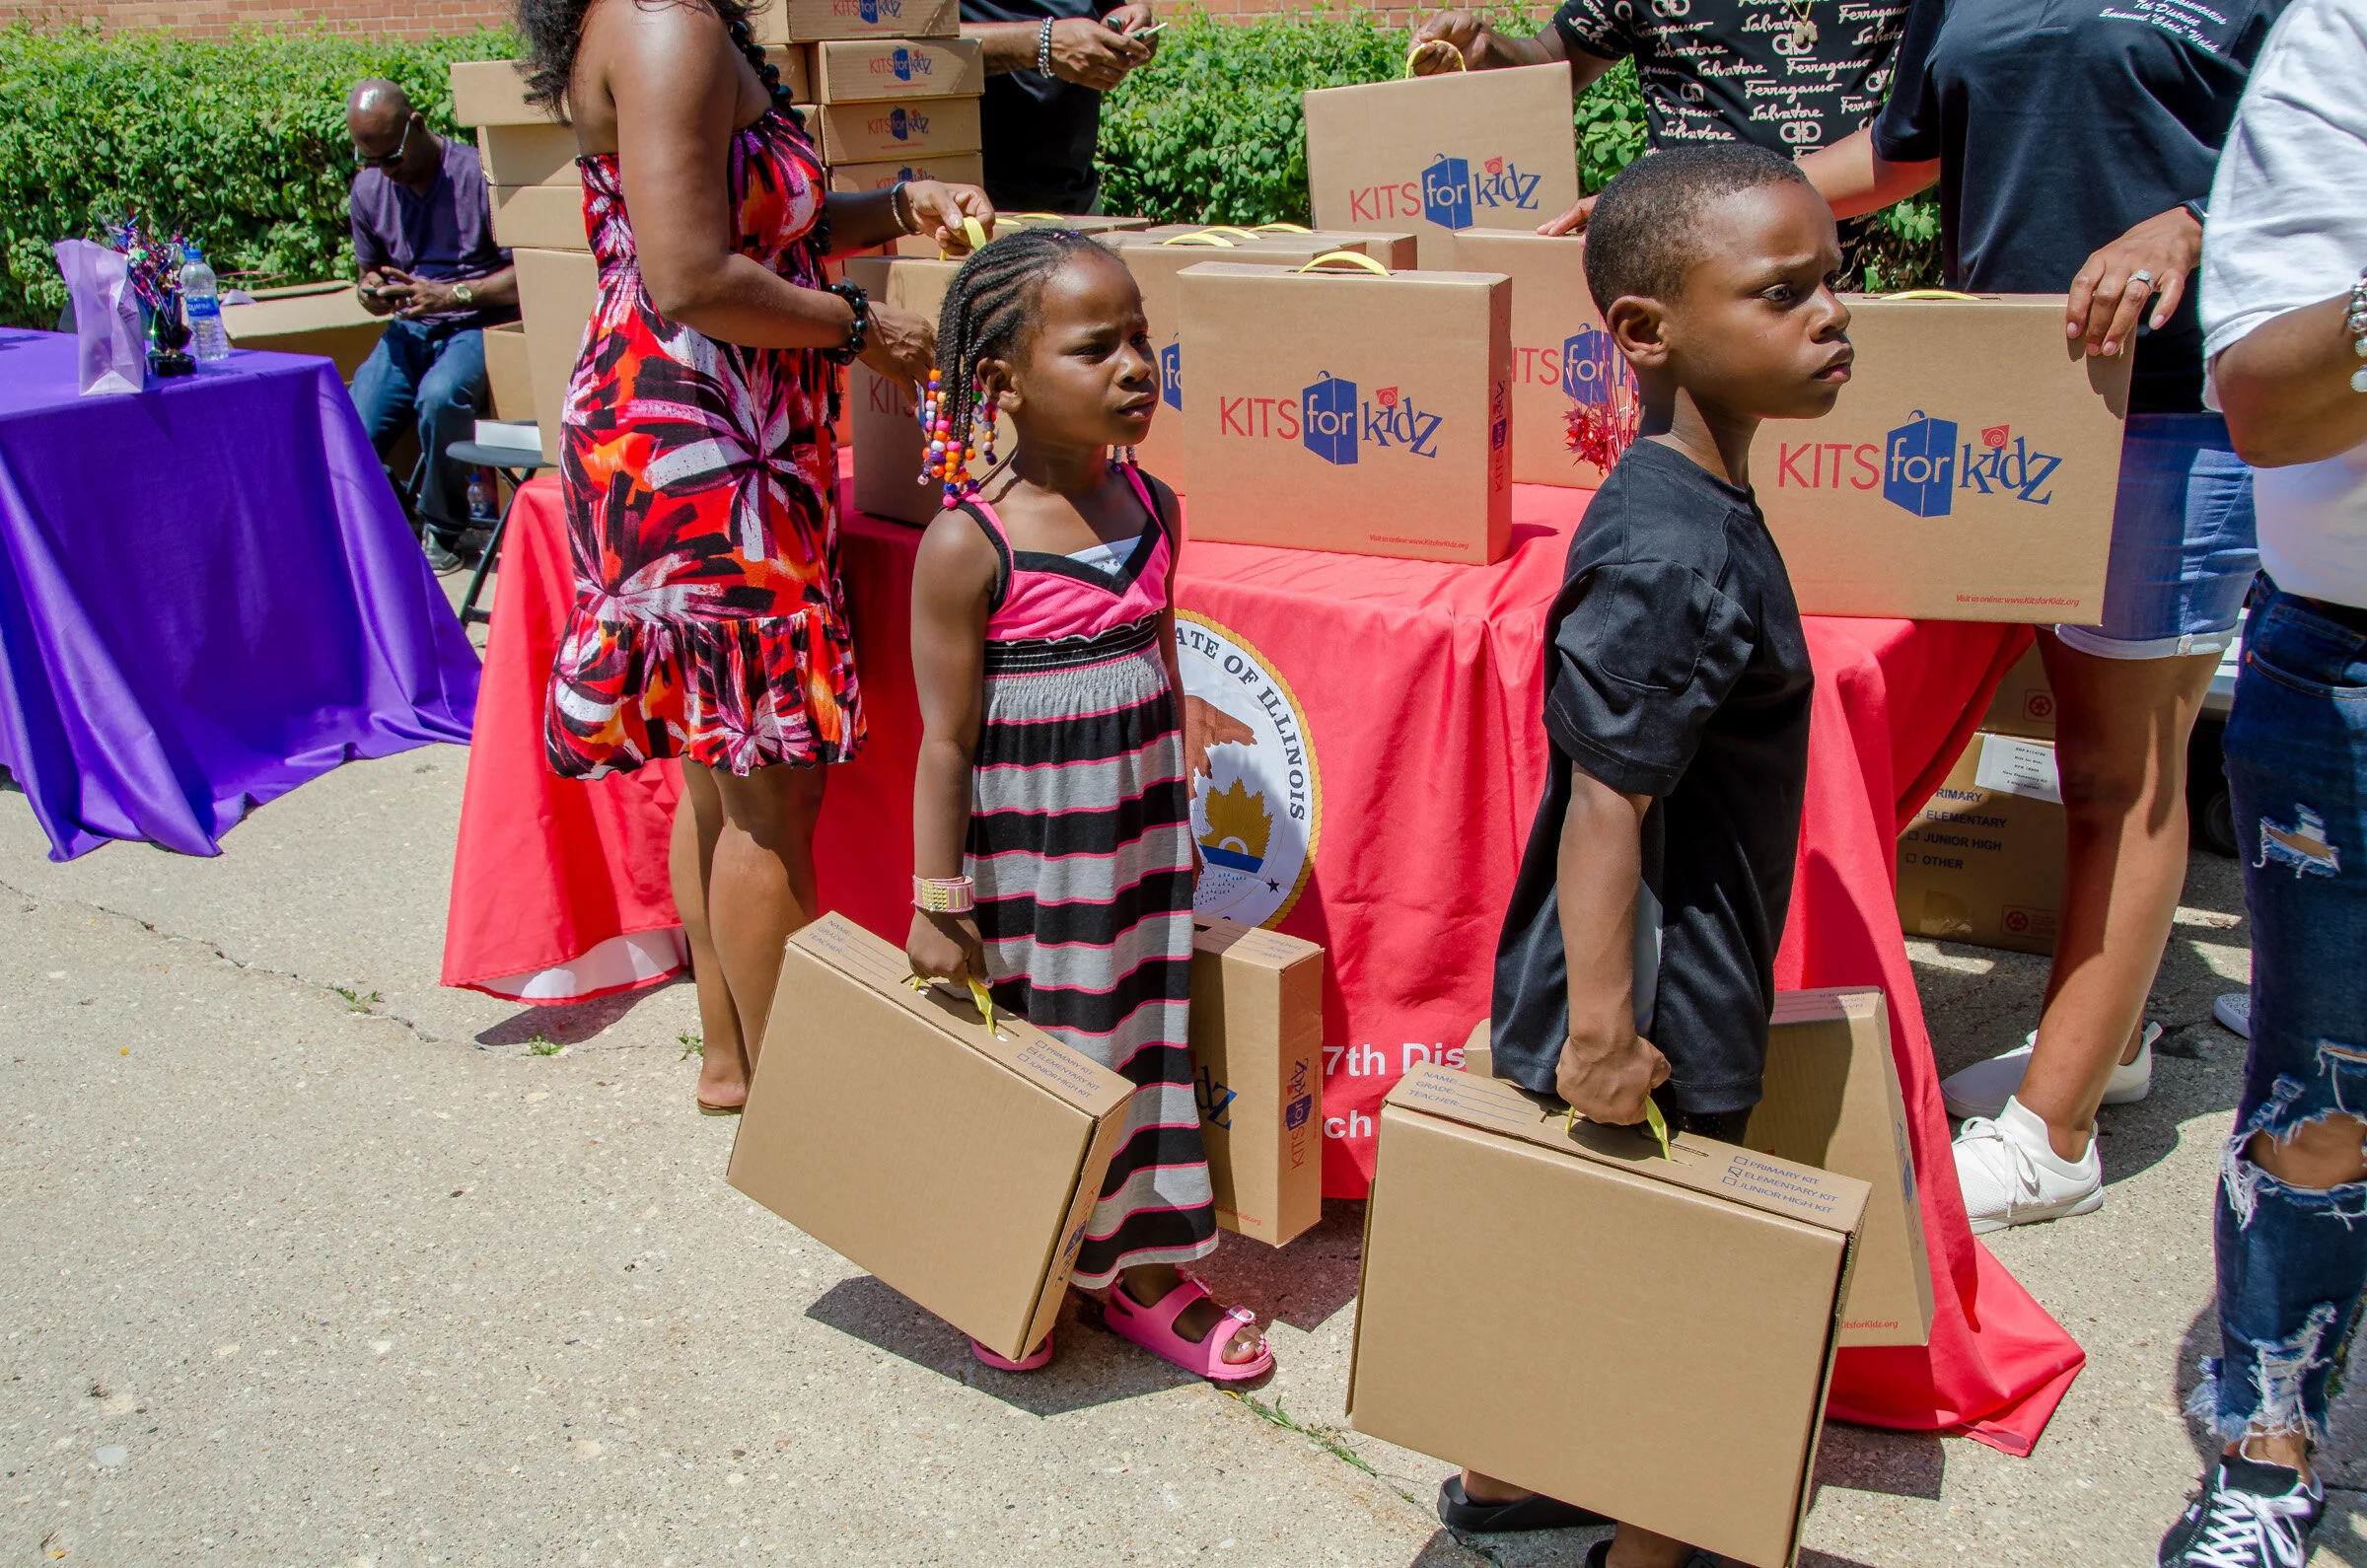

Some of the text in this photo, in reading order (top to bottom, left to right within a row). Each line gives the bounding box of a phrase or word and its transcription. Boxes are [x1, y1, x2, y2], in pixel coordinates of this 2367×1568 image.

[2154, 3, 2201, 27] District
[2099, 8, 2151, 22] Emanuel
[2188, 29, 2220, 53] Welch
[869, 57, 894, 74] KITS
[1697, 58, 1767, 78] Salvatore
[1786, 57, 1874, 81] Ferragamo
[1745, 80, 1842, 104] Ferragamo
[1749, 102, 1824, 121] Salvatore
[867, 117, 892, 135] KITS
[1660, 120, 1736, 140] Salvatore
[1349, 156, 1542, 223] KITS for kidz
[1512, 347, 1560, 386] ITS
[1568, 344, 1611, 382] for
[1220, 387, 1443, 459] KITS for kidz
[1777, 424, 2063, 506] KITS for kidz
[1956, 594, 1971, 603] Visit
[1175, 627, 1306, 821] ATE OF ILLINOIS
[1936, 788, 1982, 803] RIMARY
[1926, 810, 2007, 826] ELEMENTARY
[1923, 832, 2001, 851] JUNIOR HIGH
[1921, 854, 1963, 868] OTHER
[1038, 1053, 1102, 1091] ELEMENTARY KIT
[1046, 1046, 1094, 1075] PRIMARY KIT
[1323, 1043, 1386, 1077] 7th
[1028, 1060, 1093, 1098] JUNIOR HIGH KIT
[1290, 1103, 1304, 1127] for
[1291, 1125, 1306, 1171] KITS
[1750, 1161, 1821, 1185] PRIMARY KIT
[1739, 1182, 1834, 1214] JUNIOR HIGH KIT
[1744, 1171, 1838, 1202] ELEMENTARY KIT
